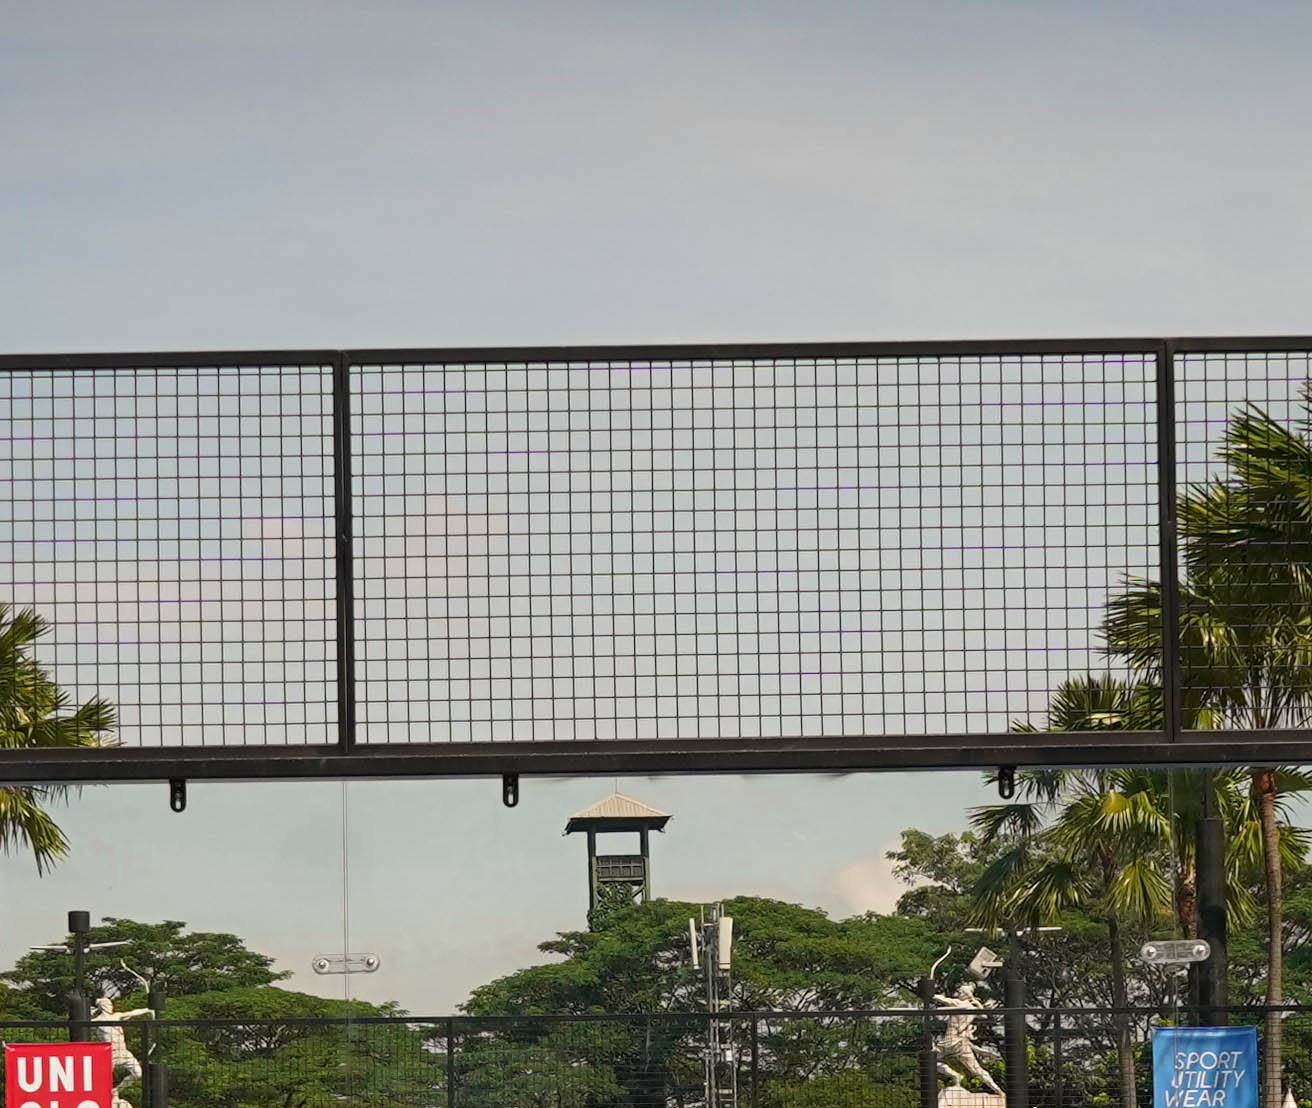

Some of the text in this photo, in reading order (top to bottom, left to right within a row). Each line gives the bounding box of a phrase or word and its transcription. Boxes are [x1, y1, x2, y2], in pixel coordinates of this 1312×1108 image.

[1174, 1051, 1243, 1070] SPORT
[17, 1055, 93, 1093] UNI
[1171, 1069, 1246, 1089] UTILITY
[1165, 1089, 1226, 1108] WEAR
